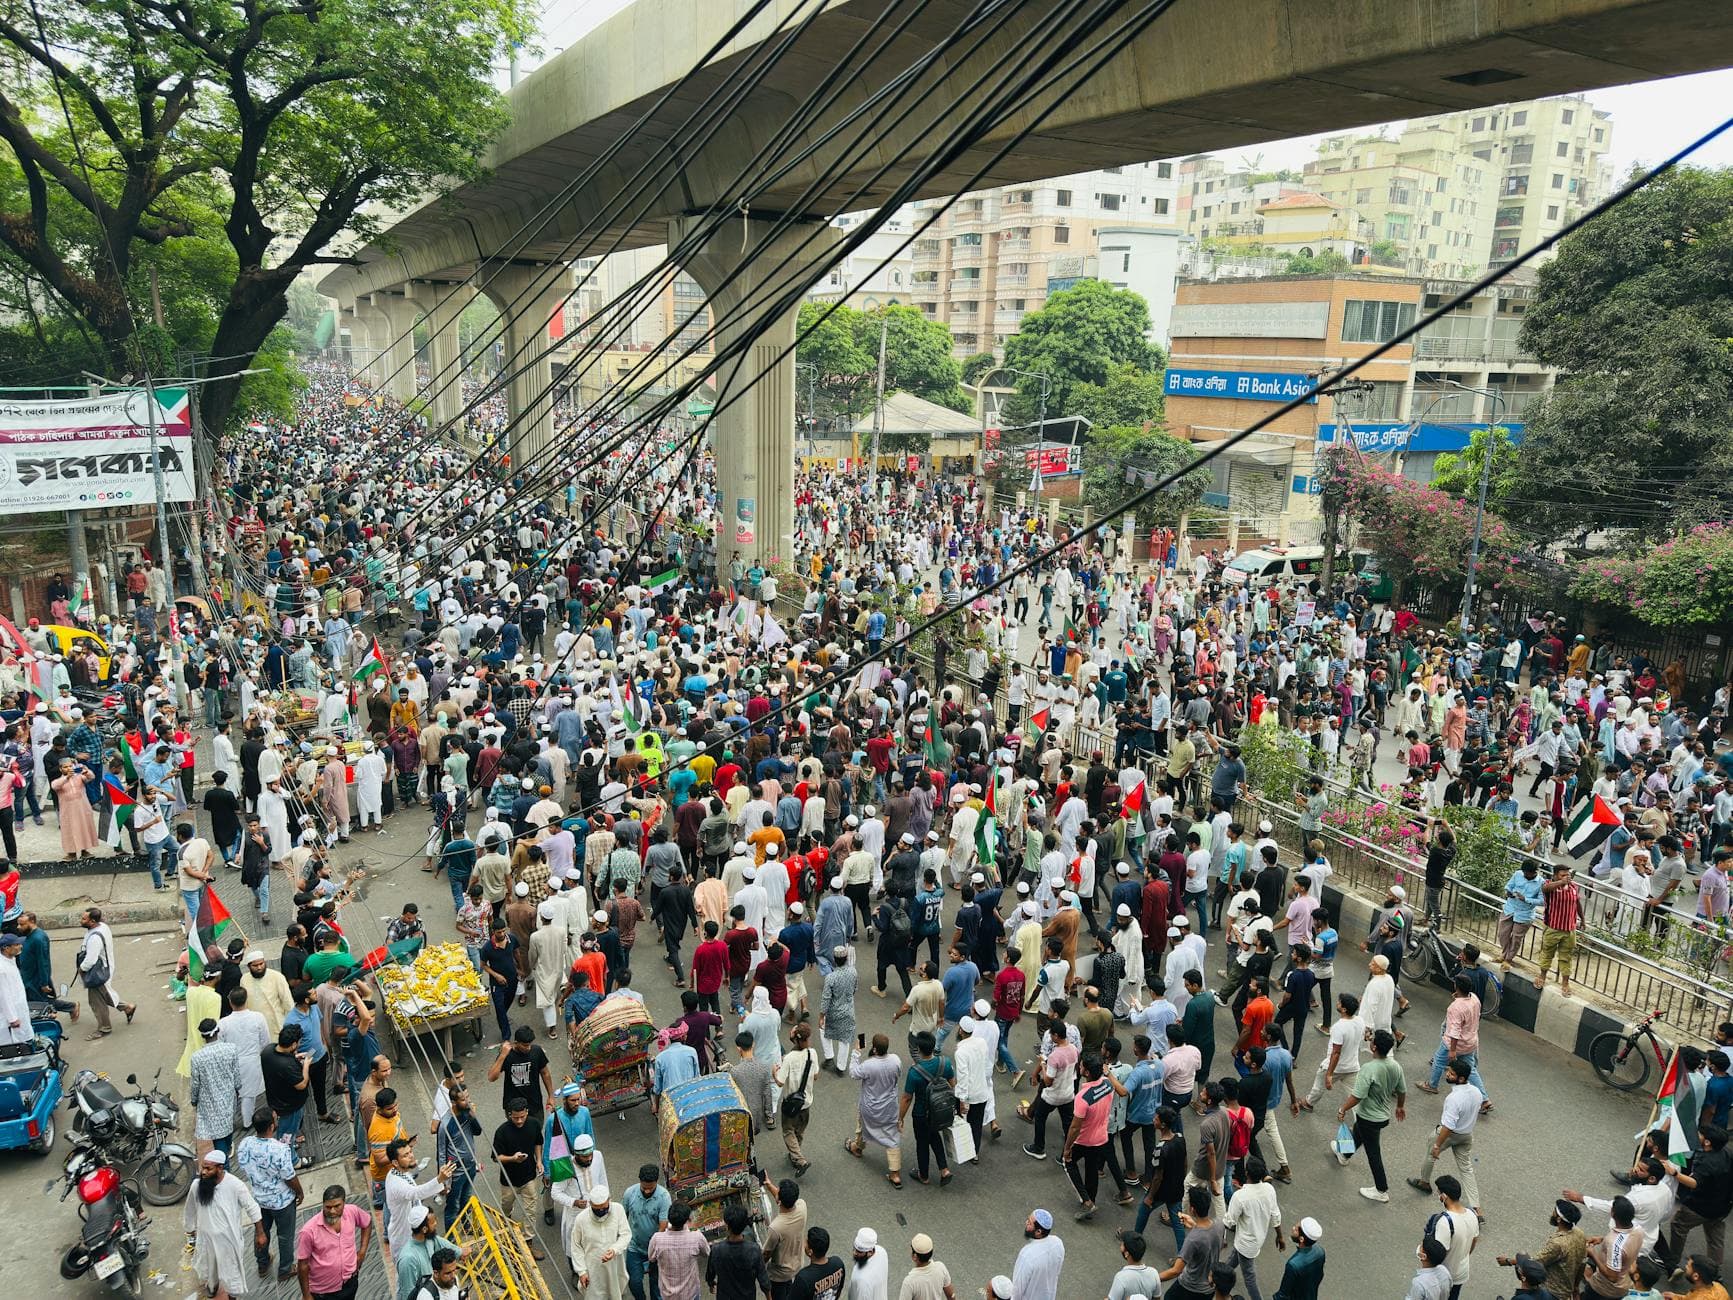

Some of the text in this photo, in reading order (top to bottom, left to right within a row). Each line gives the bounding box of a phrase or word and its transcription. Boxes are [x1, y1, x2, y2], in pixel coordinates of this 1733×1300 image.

[1251, 377, 1310, 396] Bank Asia
[0, 405, 23, 416] ৭২
